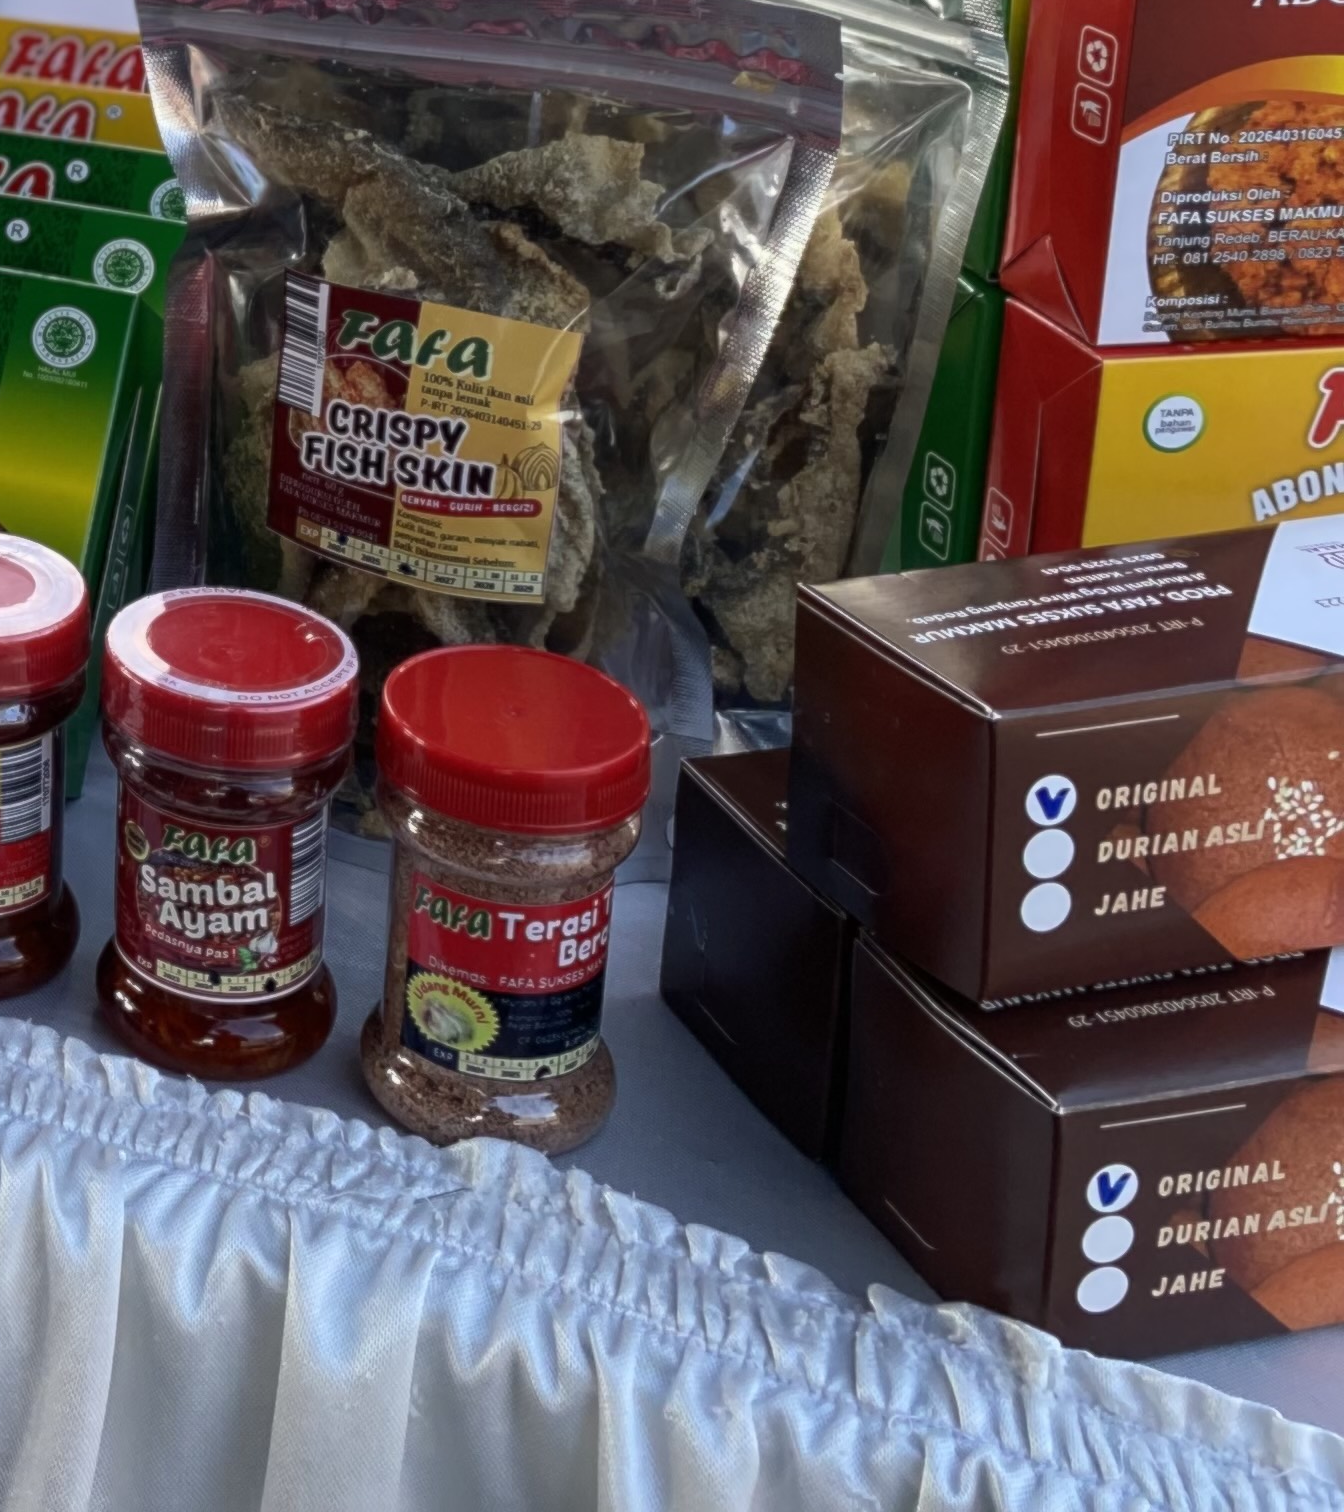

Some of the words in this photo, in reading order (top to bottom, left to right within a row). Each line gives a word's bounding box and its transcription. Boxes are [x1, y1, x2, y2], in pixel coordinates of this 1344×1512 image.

[1167, 132, 1206, 146] PIRT
[1165, 151, 1206, 166] Berat
[1209, 149, 1260, 165] Bersih
[1160, 190, 1243, 206] Diproduksi
[1245, 187, 1282, 201] Oleh
[1157, 211, 1202, 225] FAFA
[1204, 207, 1275, 223] SUKSES
[1278, 205, 1344, 221] MAKMU
[1155, 233, 1211, 249] Tanjung
[1182, 252, 1208, 265] 081
[1212, 250, 1248, 264] 2540
[1251, 248, 1286, 262] 2898
[1297, 247, 1332, 259] 0823
[336, 309, 493, 381] Fafa
[420, 384, 453, 401] tanpa
[454, 391, 492, 409] lemak
[423, 371, 455, 389] 100%
[456, 378, 484, 396] Kulit
[486, 384, 512, 400] ikan
[514, 393, 536, 407] asli
[419, 397, 448, 414] P-IRT
[1159, 408, 1195, 418] TANPA
[326, 399, 470, 457] CRISPY
[1159, 419, 1192, 428] bahan
[301, 432, 389, 484] FISH
[392, 453, 497, 499] SKIN
[1251, 461, 1344, 523] ABON
[449, 501, 483, 512] GURIH
[492, 503, 535, 513] BERGIZI
[299, 524, 319, 537] EXP
[437, 543, 459, 552] rasa
[1063, 570, 1124, 586] Kaltim
[1134, 561, 1189, 575] Berau
[1039, 591, 1083, 607] Wiro
[1102, 593, 1163, 613] FAFA
[1160, 584, 1234, 604] PROD.
[964, 597, 1040, 618] Tanjung
[1016, 602, 1106, 626] SUKSES
[907, 616, 1019, 645] MAKMUR
[1156, 616, 1205, 633] P-IRT
[237, 693, 263, 702] DO
[267, 690, 299, 702] NOT
[303, 667, 349, 696] ACCEPT
[1095, 772, 1222, 811] ORIGINAL
[162, 823, 257, 866] Fafa
[1097, 828, 1198, 863] DURIAN
[1203, 817, 1266, 848] ASLI
[140, 863, 278, 907] Sambal
[1093, 886, 1166, 917] JAHE
[159, 901, 269, 939] Ayam
[414, 885, 493, 941] Fafa
[497, 898, 599, 942] Terasi
[498, 975, 536, 990] FAFA
[538, 970, 585, 990] SUKSES
[414, 981, 451, 1000] Udang
[450, 985, 491, 1025] Murni
[1230, 984, 1277, 1004] P-IRT
[433, 1047, 454, 1061] EXP
[1157, 1159, 1287, 1198] ORIGINAL
[1156, 1212, 1261, 1248] DURIAN
[1266, 1202, 1328, 1233] ASLI
[1151, 1267, 1226, 1298] JAHE
